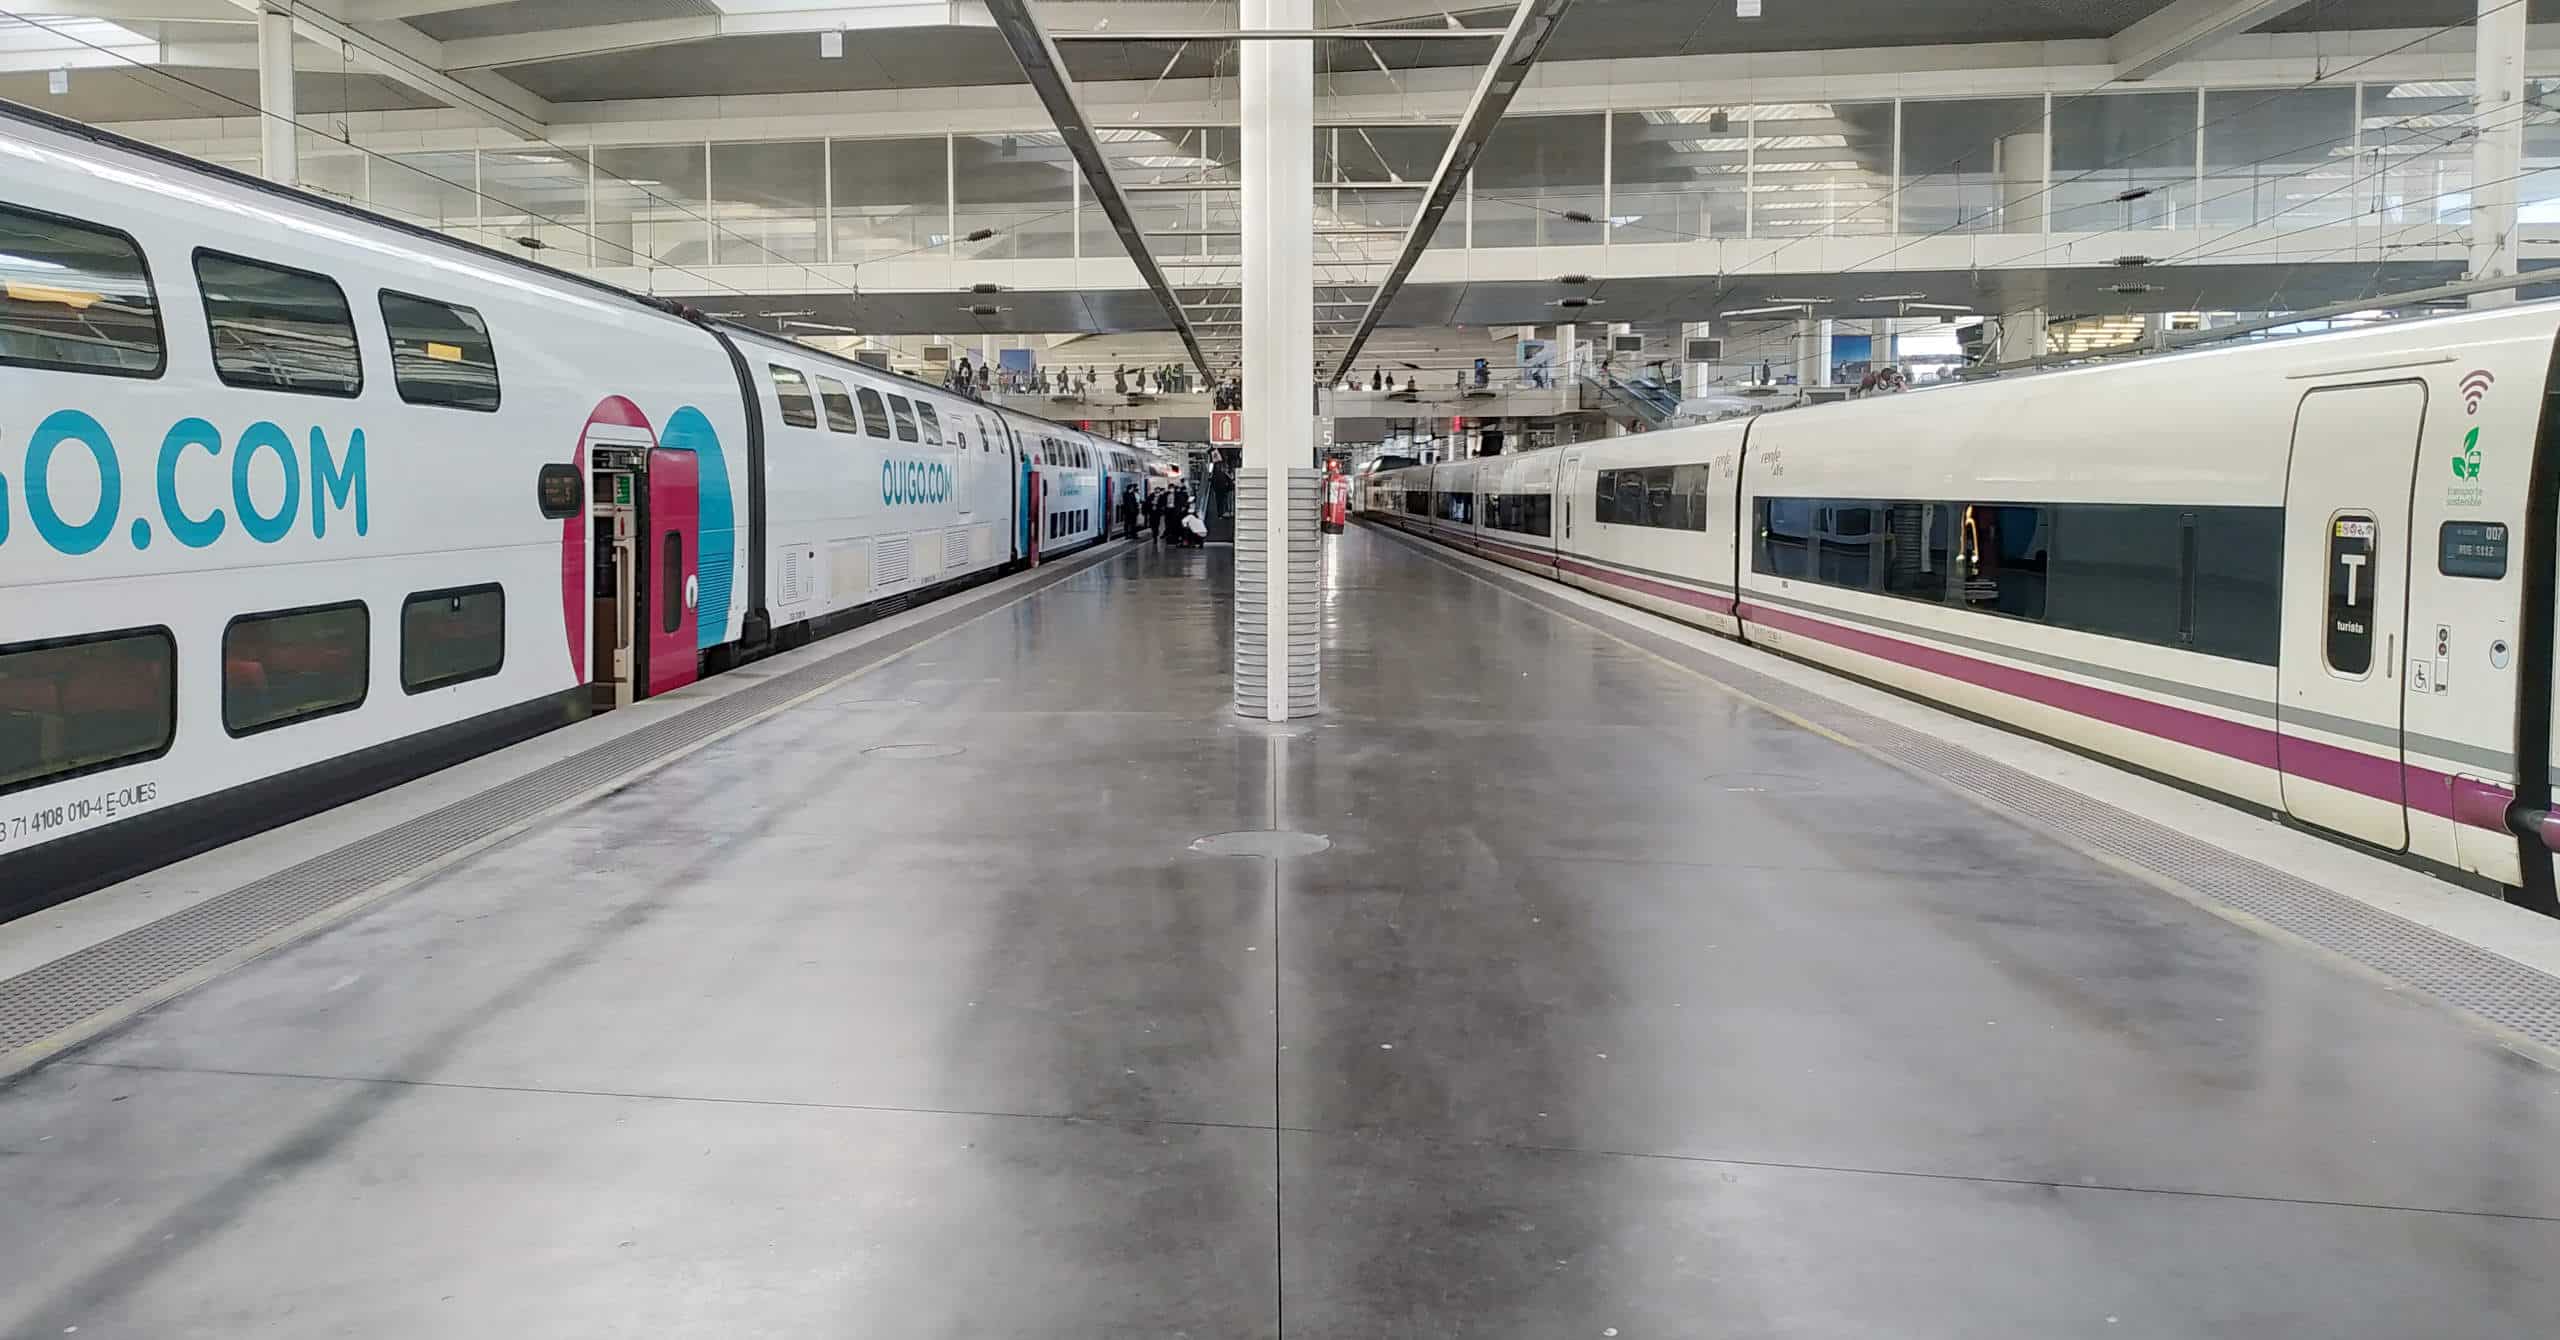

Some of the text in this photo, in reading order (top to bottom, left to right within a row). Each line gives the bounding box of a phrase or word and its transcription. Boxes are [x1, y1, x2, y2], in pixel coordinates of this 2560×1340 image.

[0, 408, 368, 555] O.COM
[882, 459, 952, 506] OUIGO.COM
[2341, 553, 2366, 606] T
[2337, 620, 2364, 634] turista
[12, 815, 28, 838] 71
[32, 806, 63, 832] 4108
[68, 794, 103, 822] 010-4
